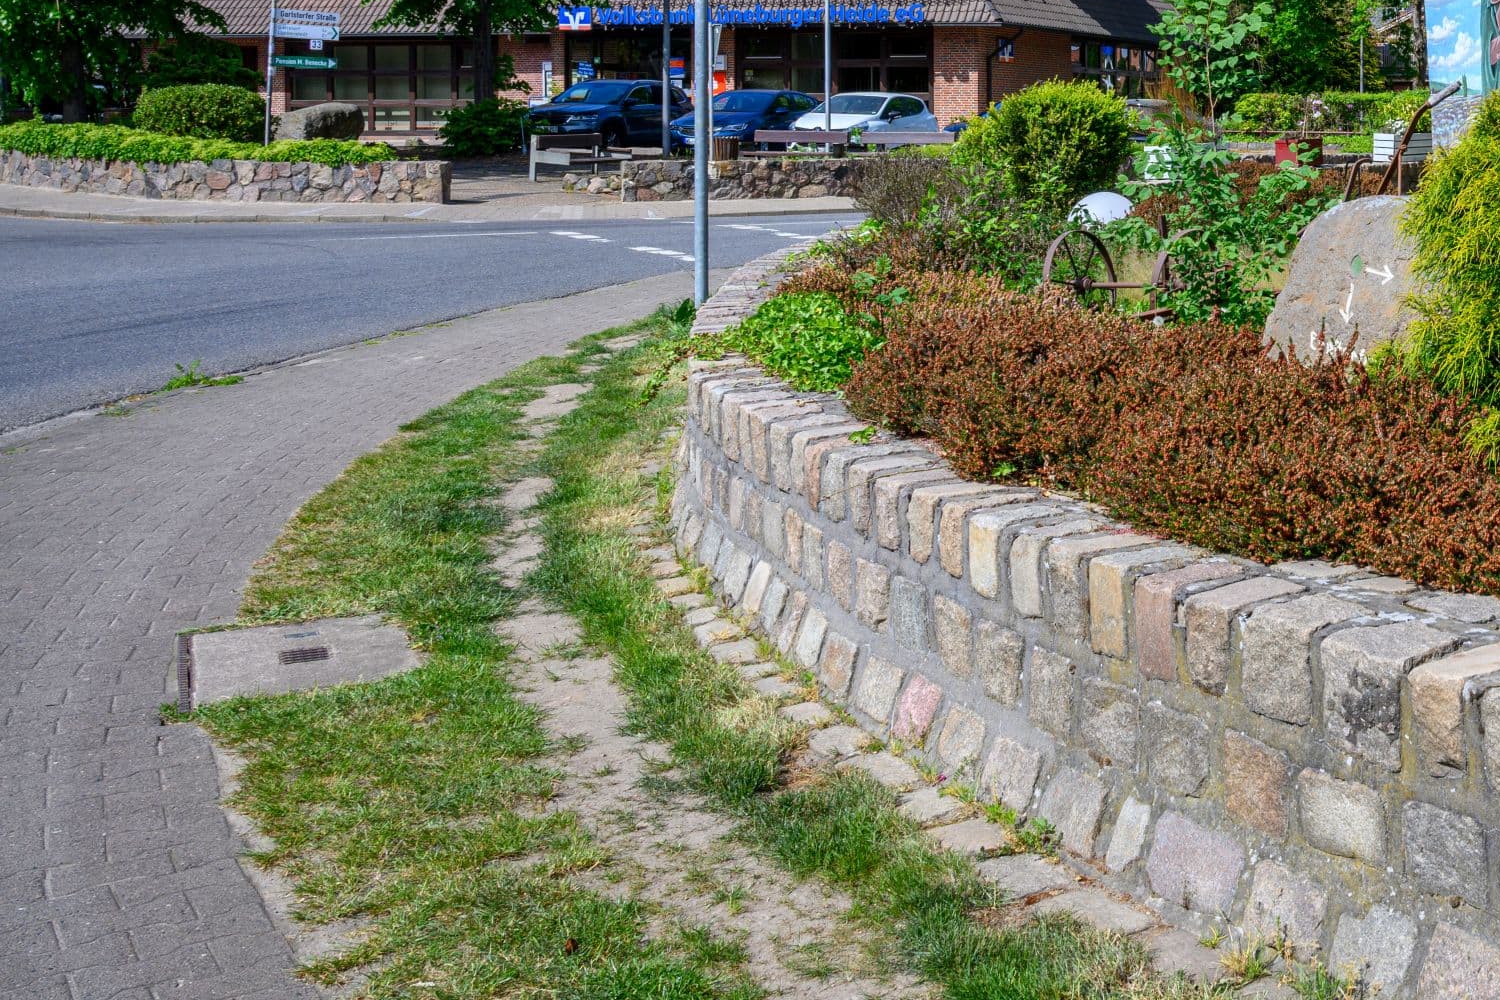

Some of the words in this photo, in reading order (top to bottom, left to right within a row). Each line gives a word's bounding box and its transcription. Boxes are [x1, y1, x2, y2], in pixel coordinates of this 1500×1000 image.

[280, 11, 315, 19] Garlstorfer
[708, 3, 823, 28] Lüneburger
[830, 2, 889, 24] Heide
[895, 3, 925, 24] eG
